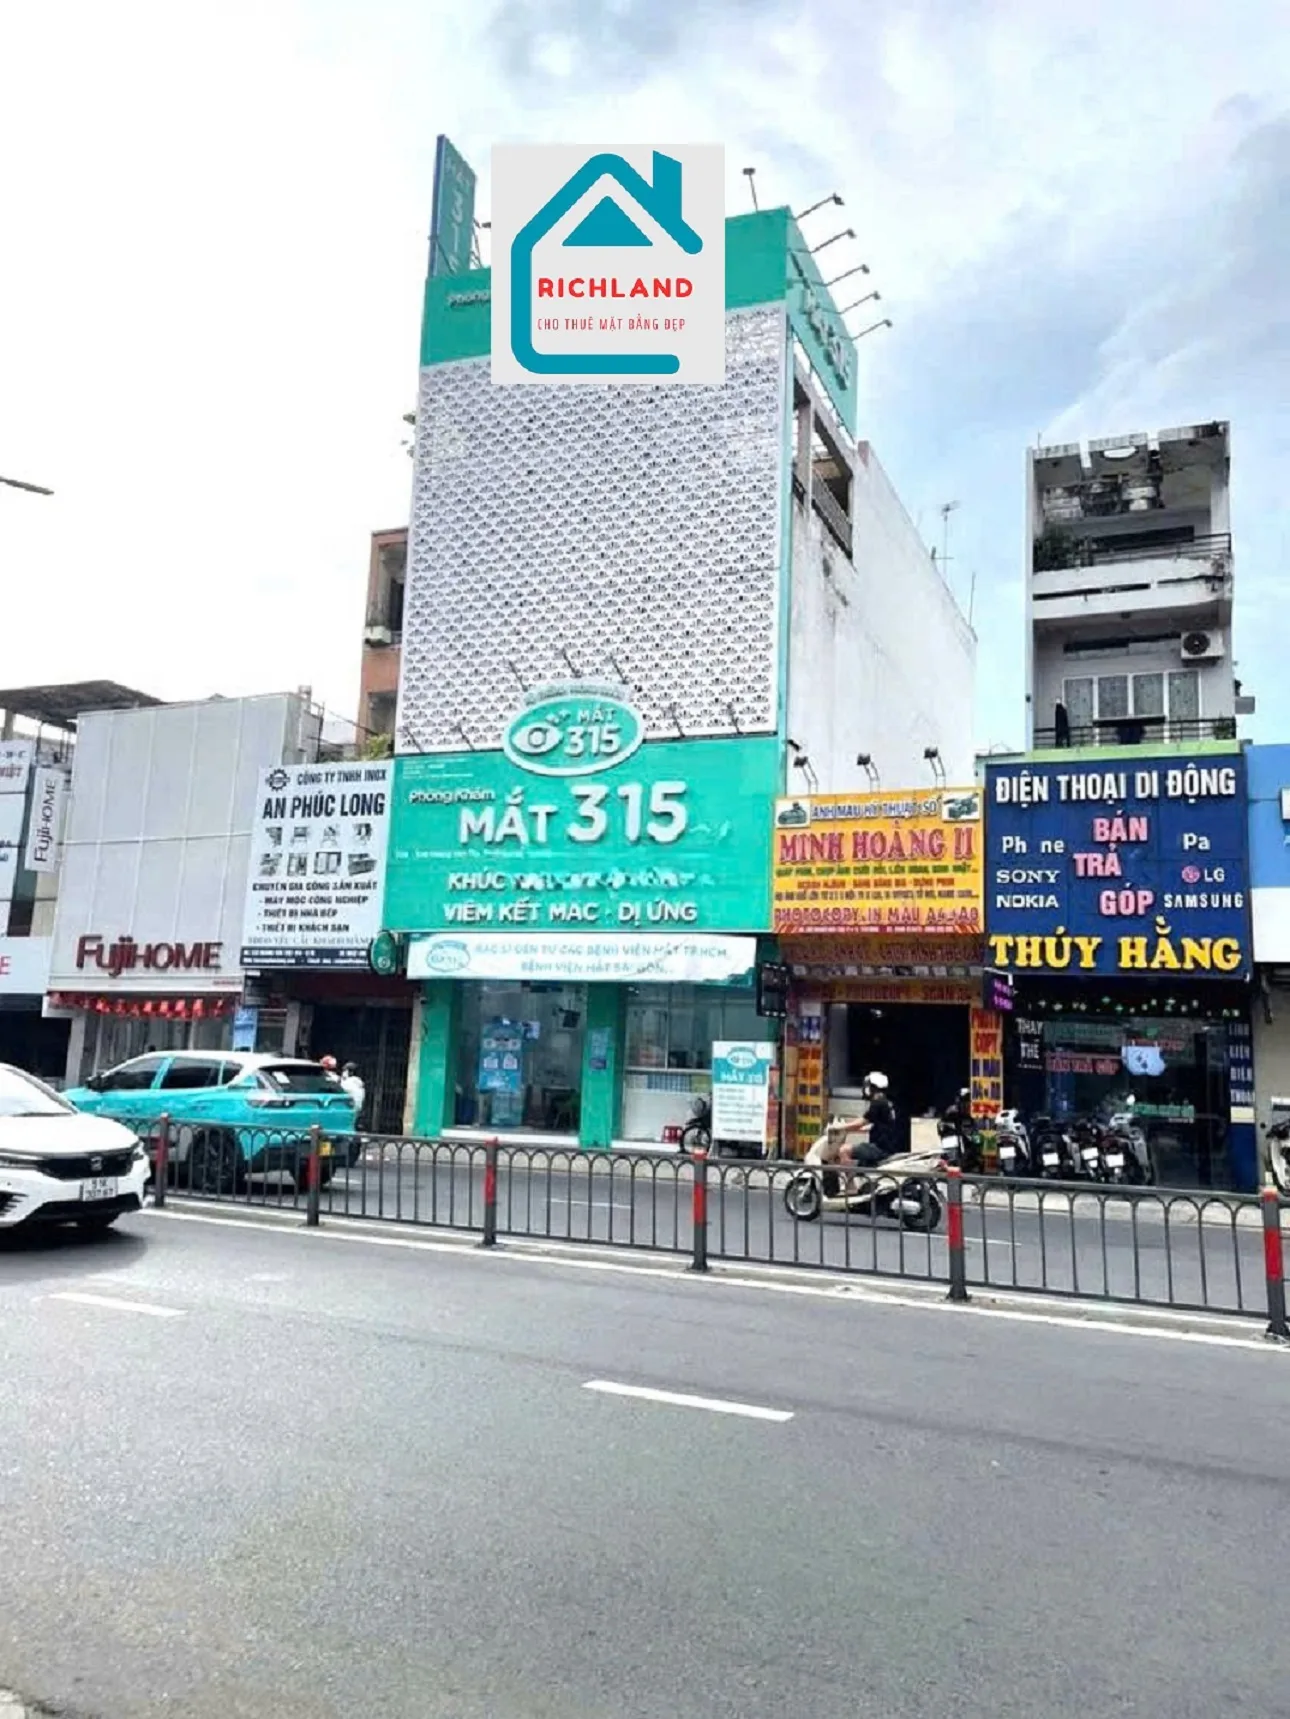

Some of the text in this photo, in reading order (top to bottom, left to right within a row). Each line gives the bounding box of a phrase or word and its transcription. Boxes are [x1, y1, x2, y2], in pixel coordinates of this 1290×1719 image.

[564, 724, 621, 757] 315
[297, 769, 387, 786] CÔNG TY TNHH INOX
[996, 762, 1236, 808] ĐIỆN THOẠI DI ĐỘNG
[262, 790, 386, 819] AN PHÚC LONG
[459, 780, 689, 845] MẮT 315
[1093, 809, 1148, 843] BÁN
[779, 832, 845, 863] MINH
[954, 827, 974, 861] II
[1002, 835, 1065, 854] Ph ne
[1183, 832, 1211, 850] Pa
[1073, 844, 1122, 877] TRẢ
[252, 881, 287, 891] CHUYÊN
[448, 865, 505, 891] KHÚC
[996, 869, 1060, 883] SONY
[1204, 869, 1225, 882] LG
[444, 901, 493, 922] VIÊM
[499, 897, 542, 922] KẾT
[618, 901, 641, 927] DỊ
[646, 899, 698, 923] ỨNG
[996, 895, 1059, 908] NOKIA
[1100, 883, 1155, 916] GÓP
[1164, 894, 1244, 908] SAMSUNG
[989, 926, 1102, 969] THÚY
[1118, 916, 1242, 971] HẰNG
